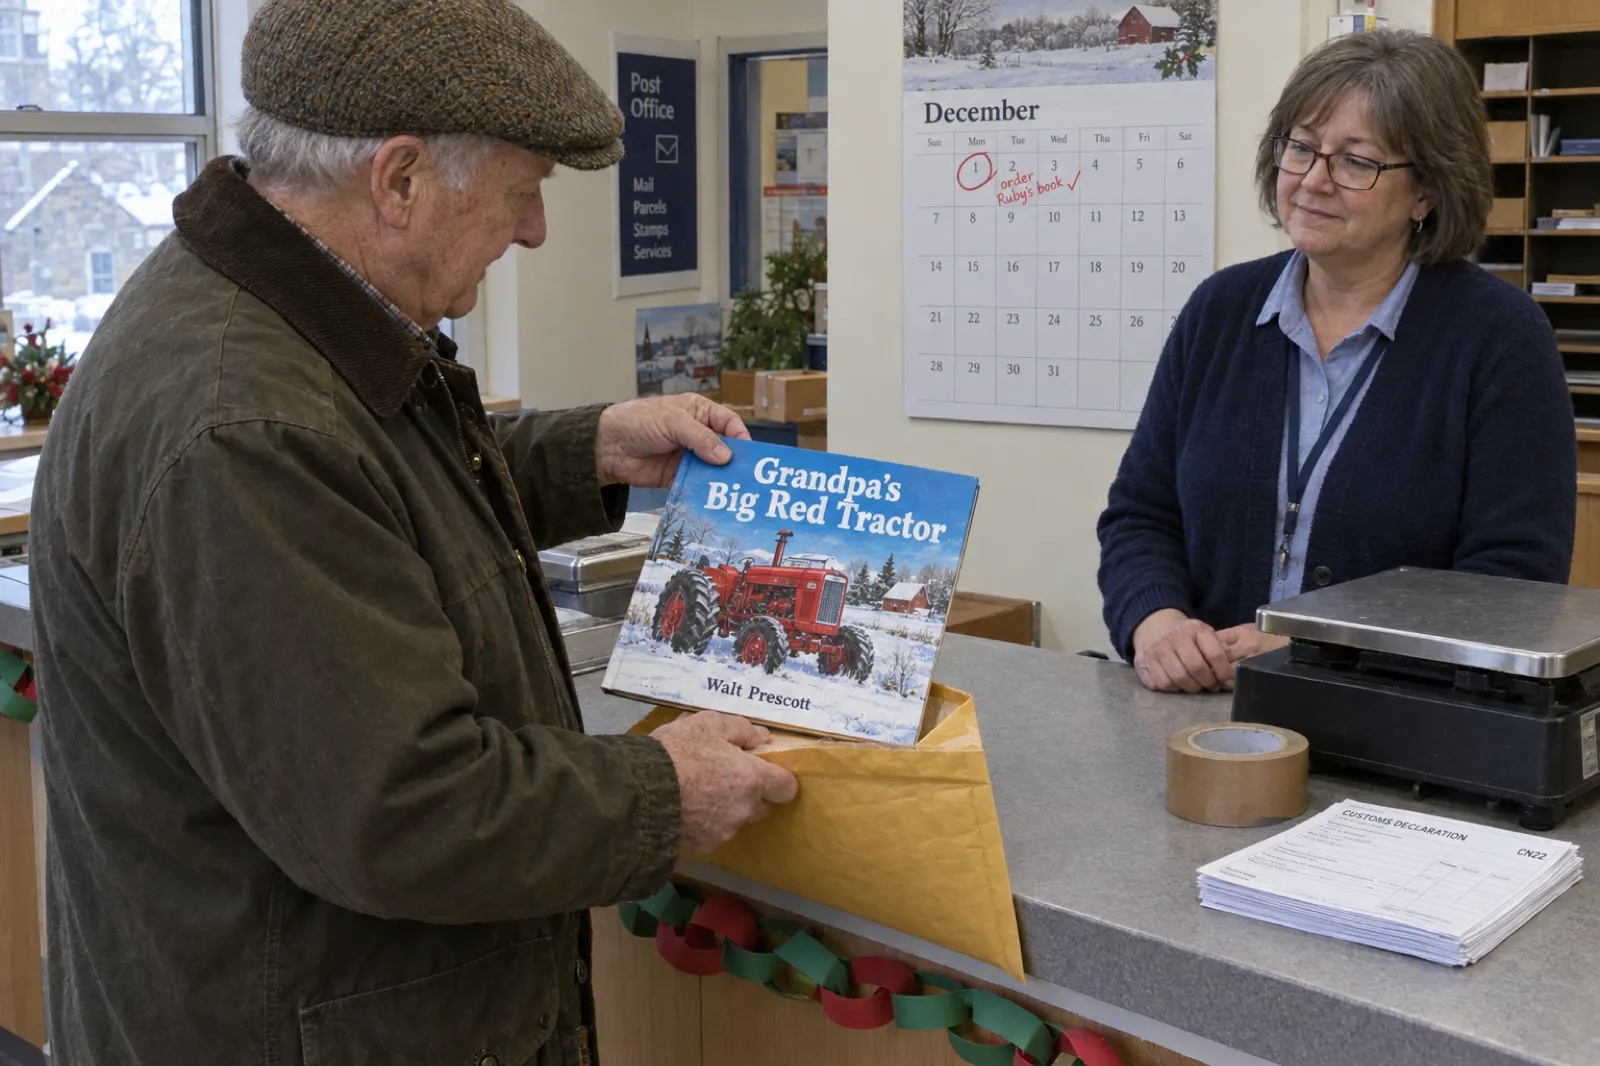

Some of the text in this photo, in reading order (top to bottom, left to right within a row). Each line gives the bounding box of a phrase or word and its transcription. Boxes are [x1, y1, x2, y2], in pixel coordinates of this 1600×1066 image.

[631, 73, 661, 93] Post
[631, 98, 674, 119] Office
[924, 99, 1039, 123] December
[927, 132, 1192, 147] Sun Mon Tue Wed Thu Fri Sat
[973, 158, 1184, 173] 1 2 3 4 5 6
[634, 178, 653, 192] Mail
[1000, 172, 1033, 190] order
[997, 176, 1064, 206] Ruby's book
[634, 200, 666, 214] Parcels
[932, 210, 1186, 223] 7 8 9 10 11 12 13
[634, 223, 668, 238] Stamps
[634, 245, 672, 259] Services
[930, 261, 1185, 273] 14 15 16 17 18 19 20
[930, 312, 1177, 328] 21 22 23 24 25 26 2
[930, 361, 1060, 377] 28 29 30 31
[754, 457, 901, 503] Grandpa's
[704, 482, 946, 543] Big Red Tractor
[708, 678, 811, 710] Walt Prescott
[1343, 810, 1393, 826] CUSTOMS
[1394, 820, 1468, 841] DECLARATION
[1518, 849, 1547, 860] CN22
